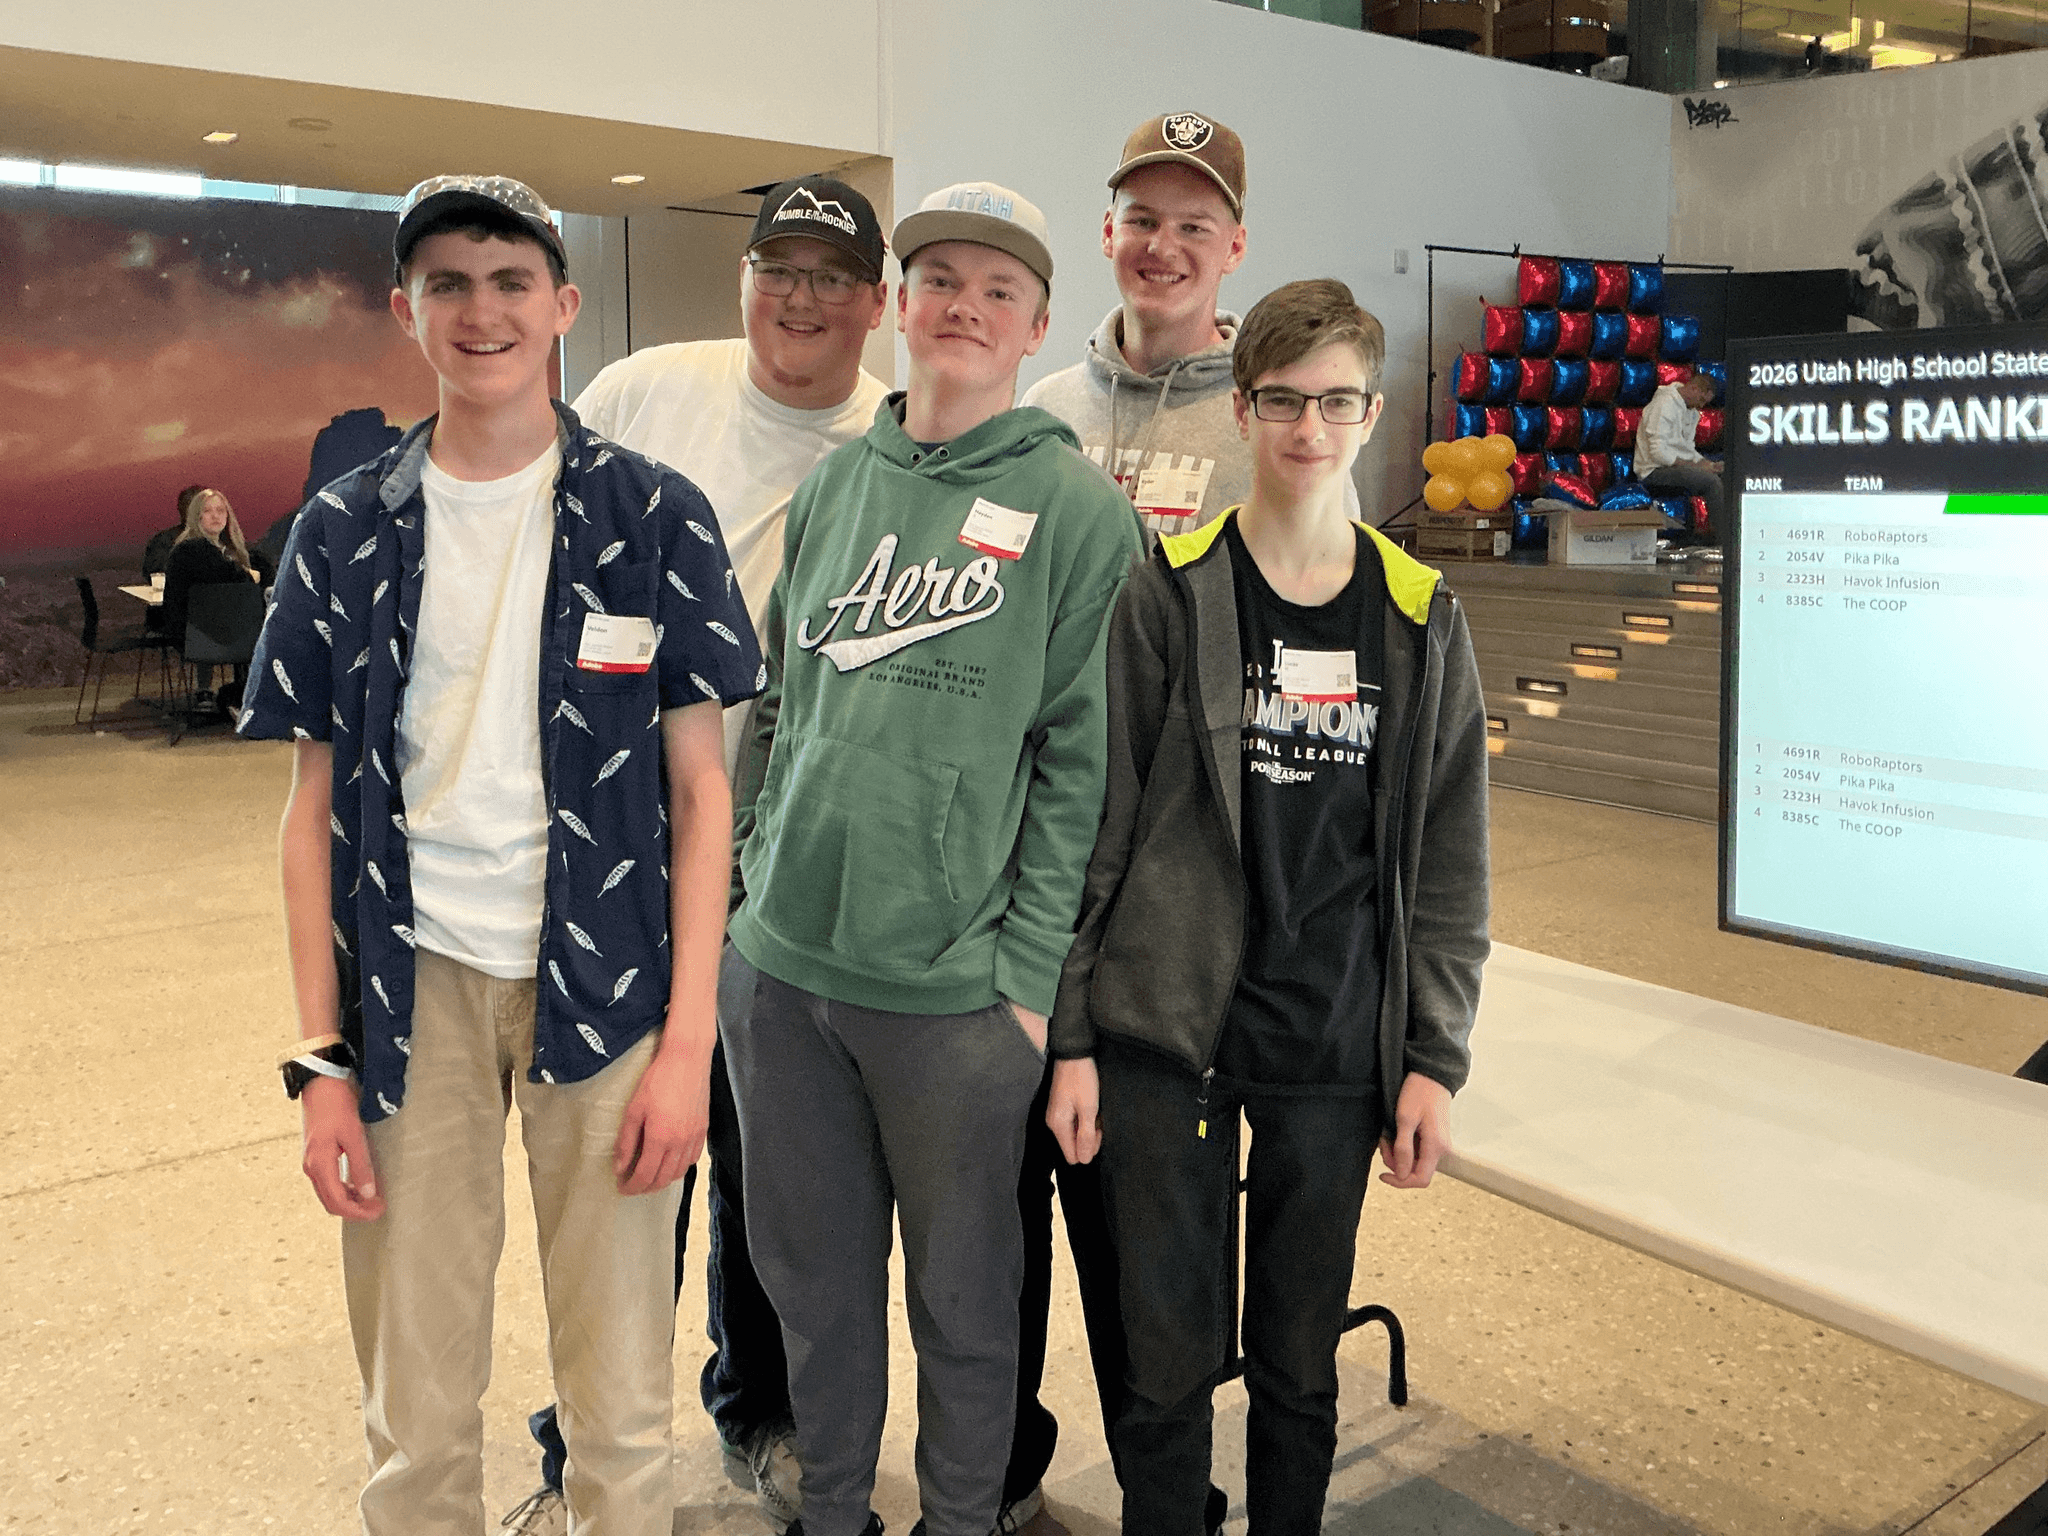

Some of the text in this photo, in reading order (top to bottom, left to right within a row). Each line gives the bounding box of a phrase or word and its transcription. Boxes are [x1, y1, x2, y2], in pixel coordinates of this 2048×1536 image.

[948, 190, 1013, 221] UTAH
[778, 209, 812, 221] RUMBLE
[821, 212, 855, 235] ROCKIES
[1749, 350, 2048, 386] 2026 Utah High School State
[1748, 400, 1889, 444] SKILLS
[1745, 477, 1883, 491] RANK TEAM
[1583, 535, 1614, 543] GILDAN
[1759, 529, 1928, 545] 1 4691R RoboRaptors
[1758, 551, 1900, 566] 2 2054V Pika Pika
[797, 533, 1006, 655] Aero
[1758, 573, 1940, 591] 3 2323H Havok Infusion
[1757, 594, 1908, 612] 4 8385C The COOP
[889, 663, 986, 688] ORIGINAL BRAND
[1293, 745, 1366, 765] LEAGUE
[1755, 743, 1923, 773] 1 4691R RoboRaptors
[1755, 764, 1895, 792] 2 2054V Pika Pika
[1754, 785, 1935, 821] 3 2323H Havok Infusion
[1754, 807, 1903, 838] 4 8385C The COOP
